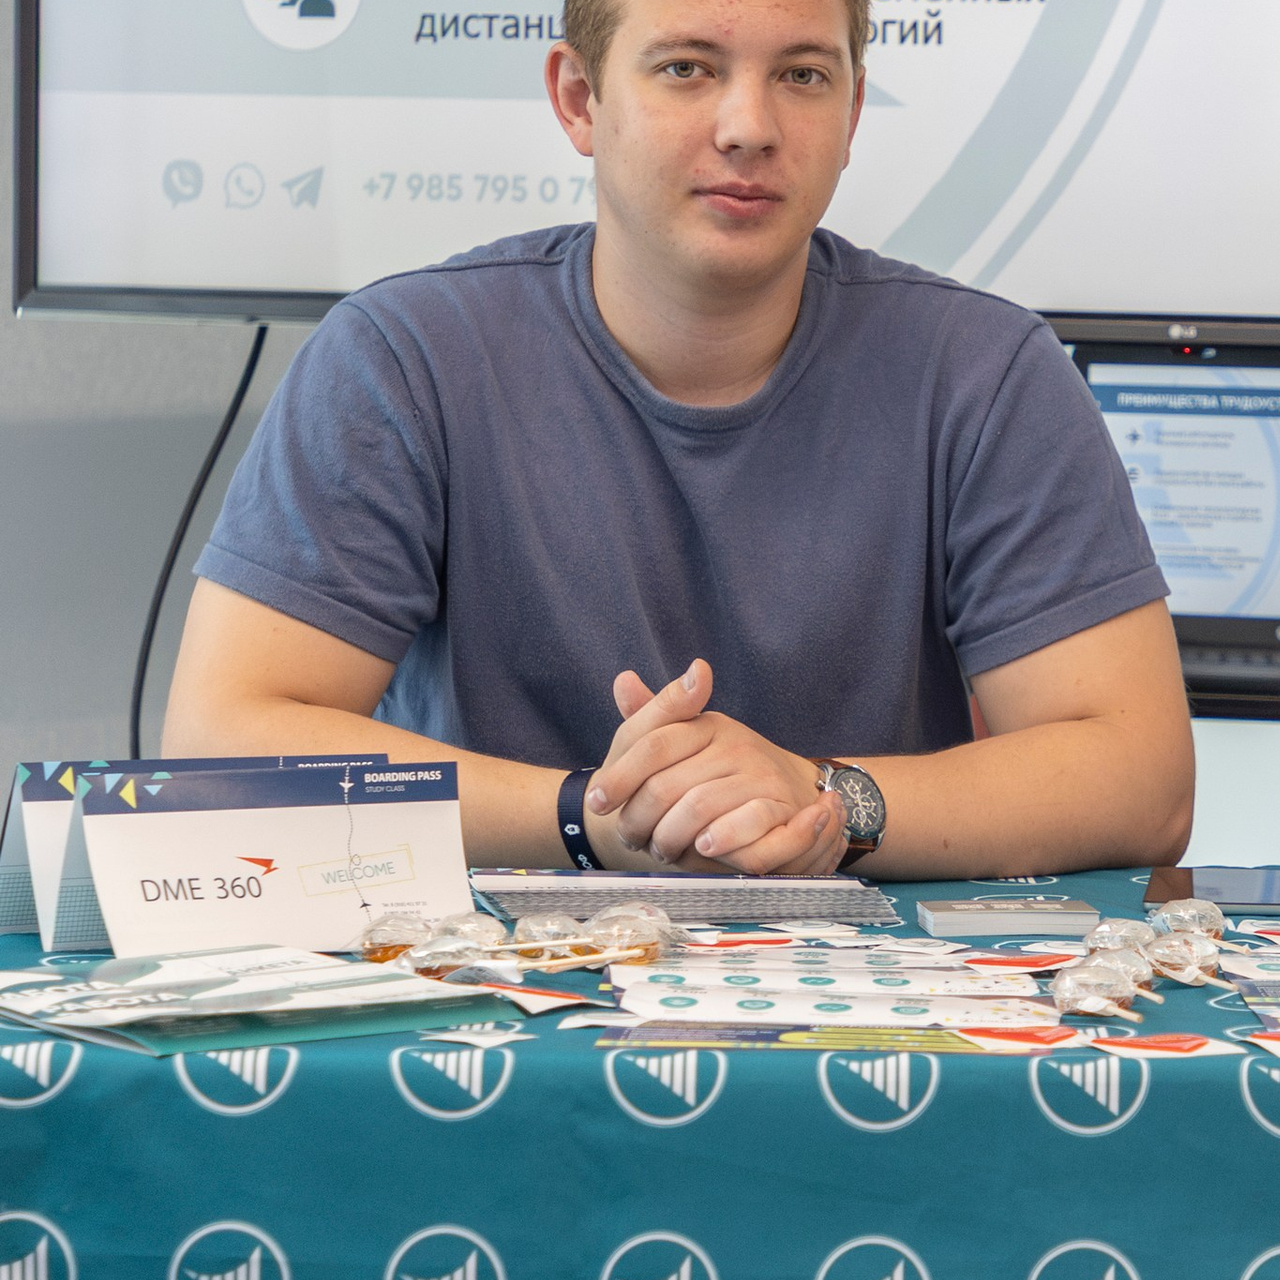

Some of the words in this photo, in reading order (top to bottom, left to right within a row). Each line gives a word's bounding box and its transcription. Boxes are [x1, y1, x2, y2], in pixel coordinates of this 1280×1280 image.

[363, 173, 396, 201] +7
[406, 173, 462, 201] 985
[474, 173, 529, 203] 795
[364, 772, 416, 783] BOARDING
[417, 771, 441, 780] PASS
[321, 862, 396, 884] WELCOME
[140, 878, 205, 902] DME
[213, 875, 262, 900] 360
